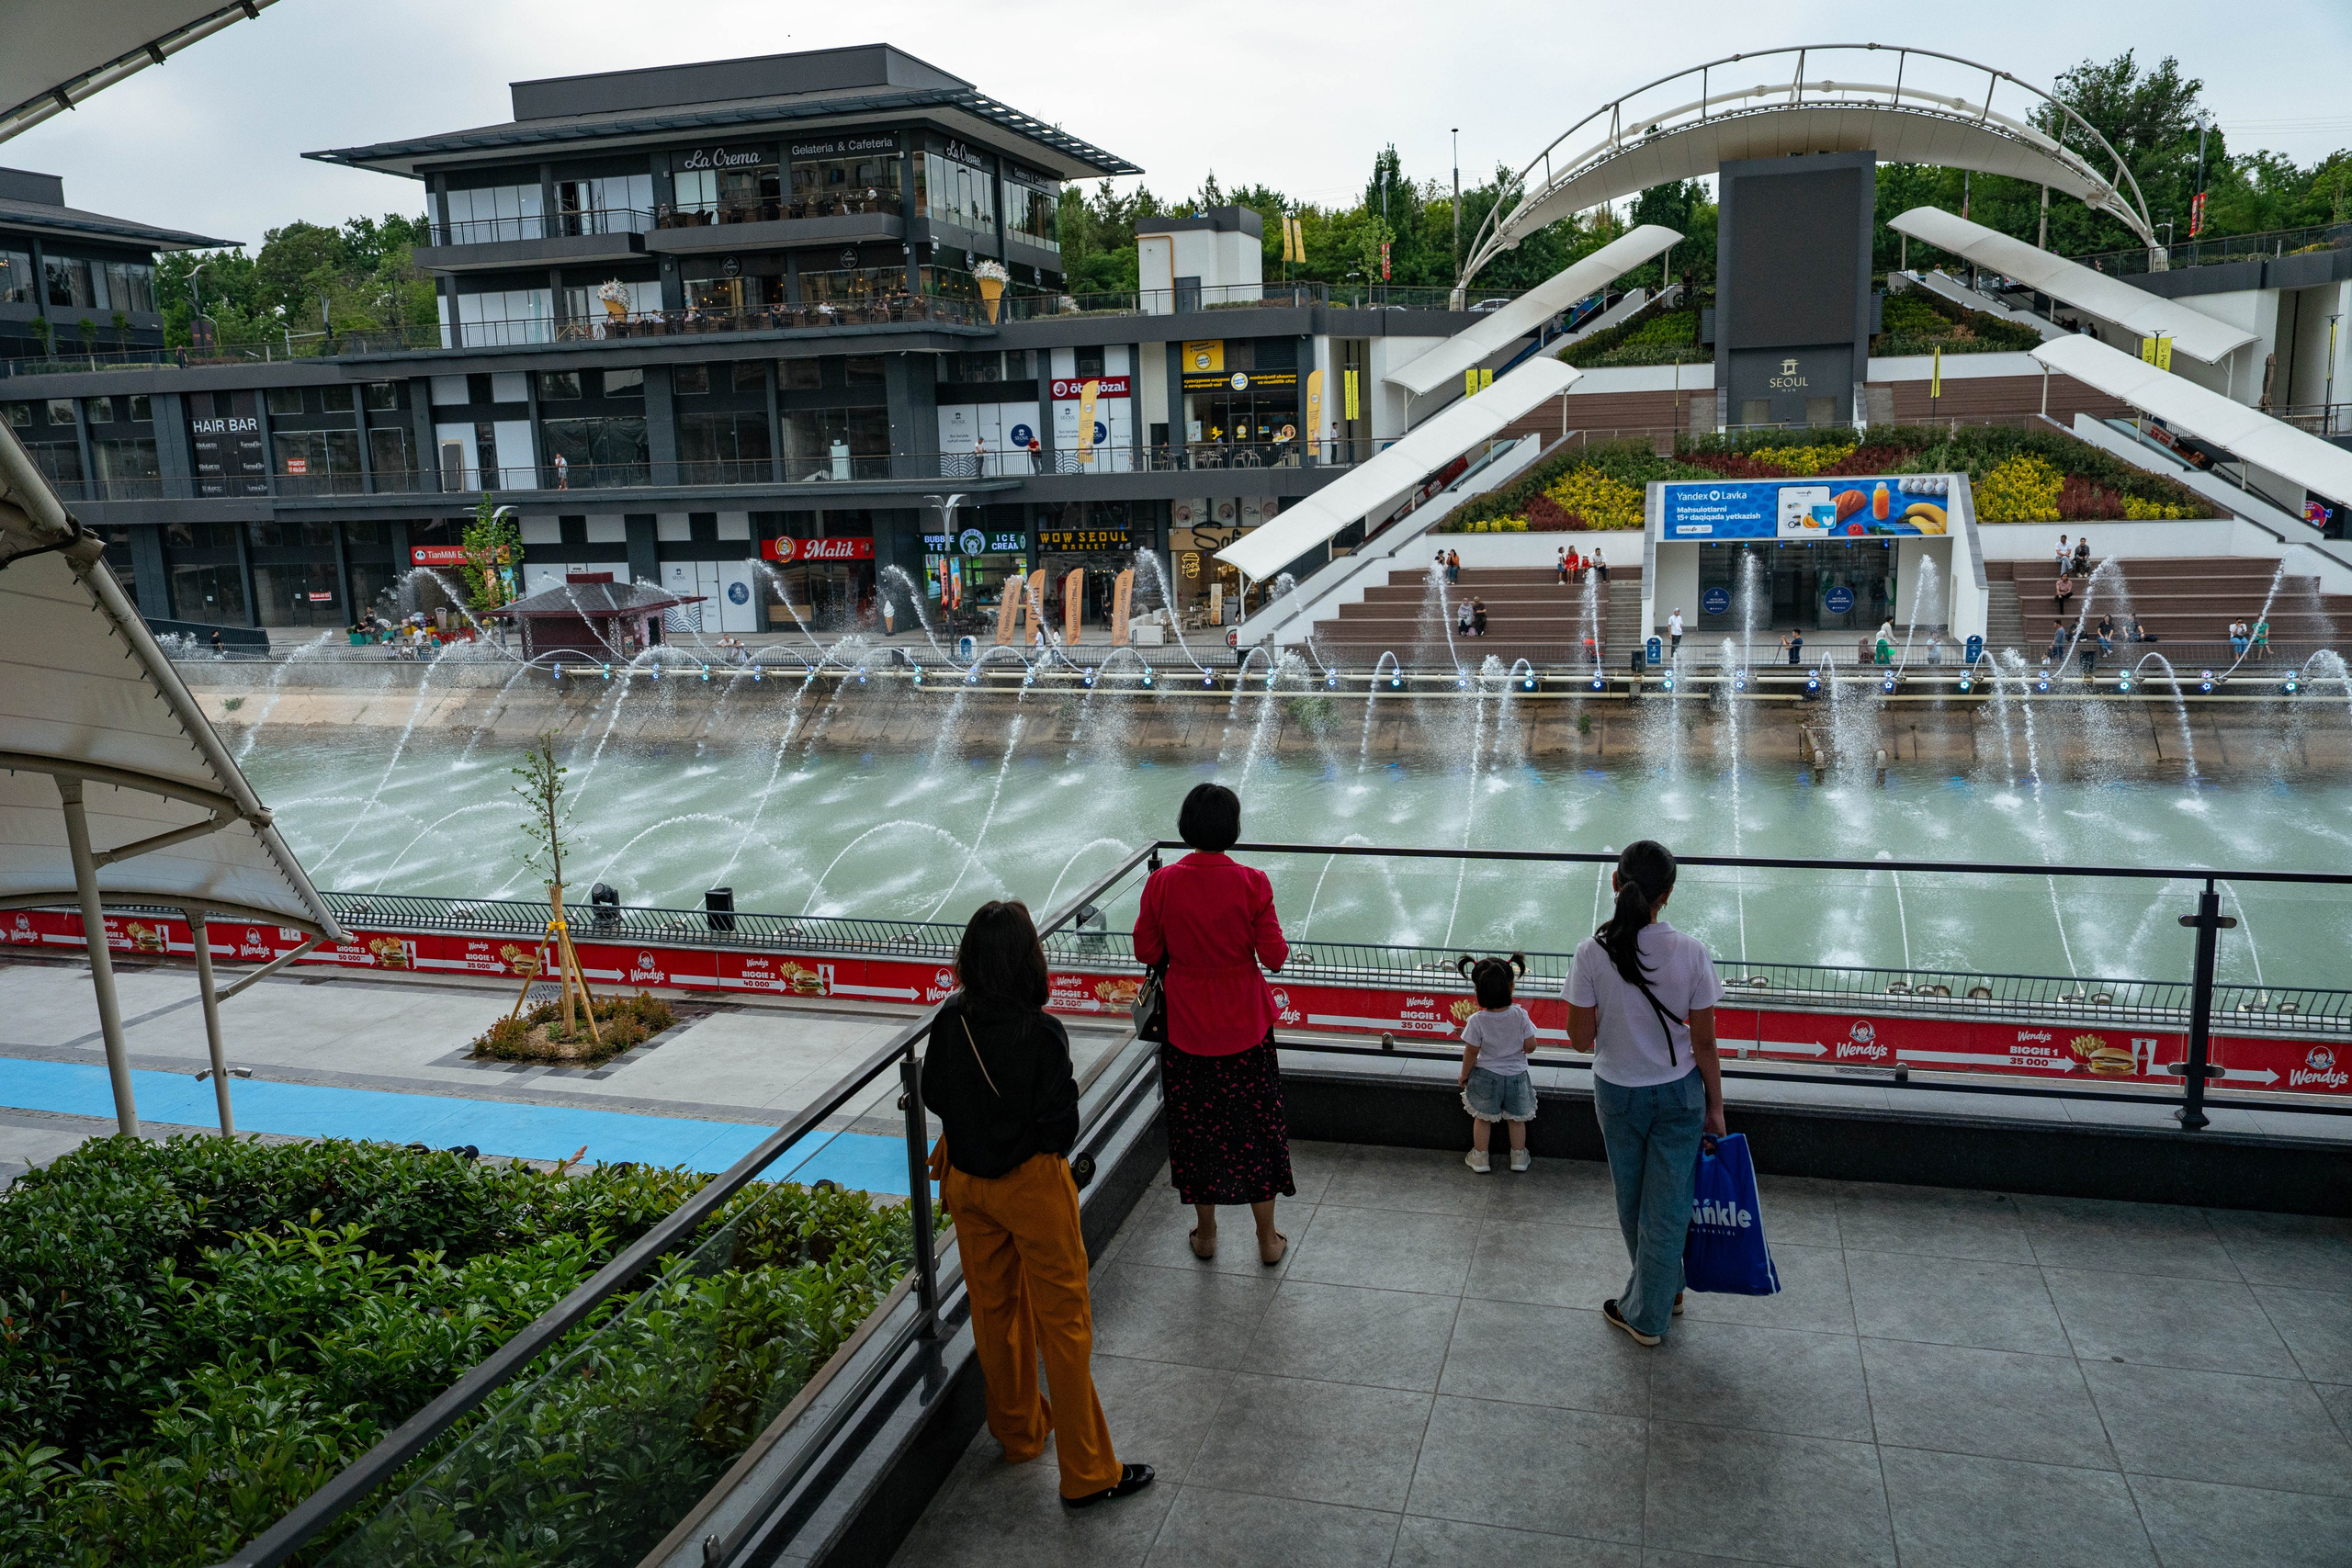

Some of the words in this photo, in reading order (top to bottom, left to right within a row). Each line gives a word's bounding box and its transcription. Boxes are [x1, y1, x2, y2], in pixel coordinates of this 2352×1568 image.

[792, 143, 833, 155] Gelateria
[837, 141, 846, 151] &
[848, 138, 893, 151] Cafeteria
[684, 150, 711, 169] La
[713, 148, 762, 166] Crema
[959, 144, 981, 167] Crema
[1770, 377, 1808, 388] SEOUL
[193, 420, 225, 433] HAIR
[229, 418, 257, 431] BAR
[1678, 492, 1708, 501] Yandex
[1722, 491, 1747, 500] Lavka
[1725, 513, 1760, 521] yetkazish
[1040, 533, 1072, 543] WOW
[1079, 532, 1127, 542] SEOUL
[804, 539, 854, 558] Malik
[10, 929, 38, 942] Wendy's
[241, 943, 270, 958] Wendy's
[336, 945, 360, 953] BIGGIE
[469, 941, 489, 951] Wendy's
[746, 958, 769, 968] Wendy's
[630, 967, 665, 985] Wendy's
[741, 971, 769, 979] BIGGIE
[1057, 976, 1082, 987] Wendy's
[926, 986, 954, 1001] Wend
[1051, 989, 1081, 998] BIGGIE
[1406, 997, 1434, 1009] Wendy's
[1279, 1007, 1301, 1024] dy's
[1400, 1010, 1434, 1020] BIGGIE
[2018, 1031, 2052, 1043] Wendy's
[1837, 1041, 1888, 1060] Wendy's
[2010, 1045, 2051, 1055] BIGGIE
[2052, 1048, 2058, 1056] 1
[2026, 1058, 2048, 1066] 000
[2290, 1067, 2349, 1089] Wendy's
